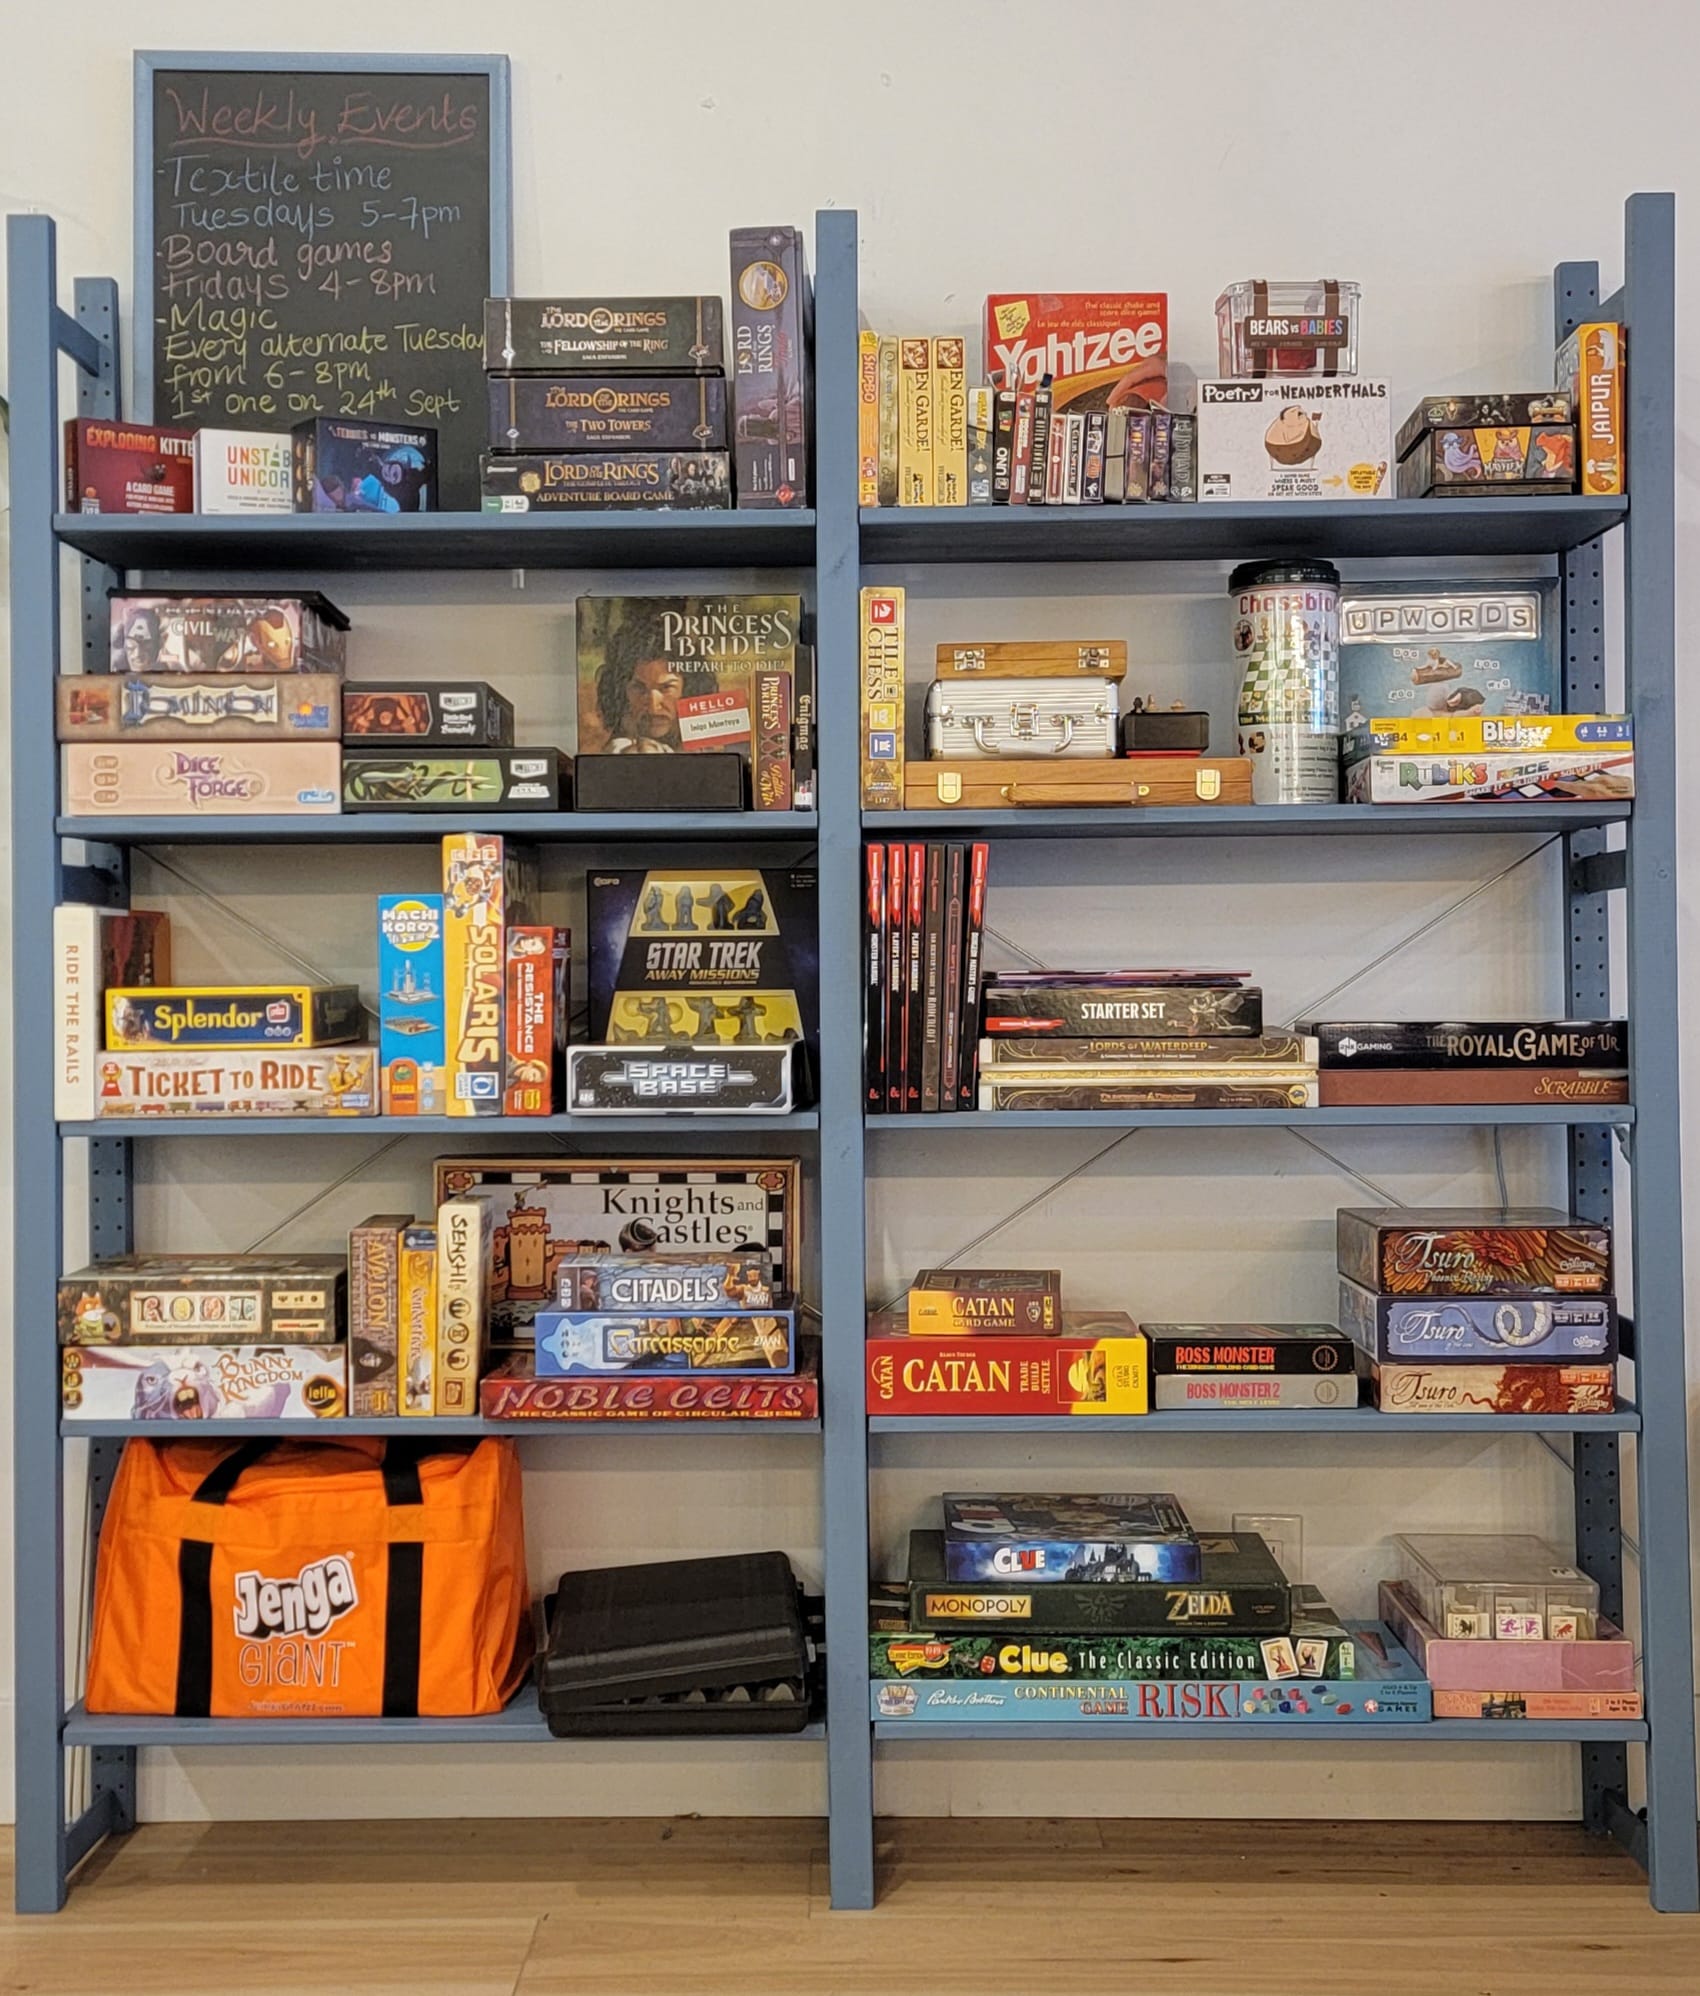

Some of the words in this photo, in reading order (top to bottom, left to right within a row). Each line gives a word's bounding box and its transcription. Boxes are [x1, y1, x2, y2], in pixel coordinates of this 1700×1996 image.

[166, 86, 320, 159] Weekly
[337, 91, 478, 134] Events
[163, 155, 300, 197] Textile
[310, 156, 392, 192] time
[170, 198, 334, 240] Tuesdays
[162, 235, 278, 269] Board
[297, 240, 392, 280] games
[161, 270, 289, 306] Fridays
[170, 299, 278, 339] Magic
[541, 311, 588, 328] LORD
[613, 312, 666, 327] RINGS
[1250, 319, 1289, 336] BEARS
[1301, 319, 1343, 336] BABIES
[163, 331, 248, 371] Every
[261, 326, 389, 357] alternate
[554, 339, 619, 354] FELLOWSHIP
[643, 339, 668, 353] RING
[737, 325, 753, 374] LORD
[757, 324, 773, 373] RINGS
[993, 322, 1162, 391] Yahtzee
[163, 364, 246, 391] from
[916, 371, 929, 391] EN
[951, 371, 963, 390] EN
[170, 388, 213, 420] 1st
[225, 392, 276, 414] one
[287, 394, 324, 412] on
[338, 380, 397, 416] 24th
[404, 388, 461, 417] Sept
[545, 392, 592, 408] LORD
[621, 392, 671, 407] RINGS
[1204, 385, 1261, 402] Poetry
[1281, 383, 1387, 400] NEANDERTHALS
[951, 395, 964, 452] GARDE!
[1591, 373, 1613, 445] JAIPUR
[86, 425, 156, 452] EXPLODING
[581, 420, 606, 431] TWO
[608, 419, 651, 432] TOWERS
[916, 396, 930, 452] GARDE!
[544, 461, 590, 487] LORD
[603, 463, 660, 485] RINGS
[996, 447, 1008, 476] UNO
[126, 481, 131, 491] A
[132, 483, 152, 495] CARD
[153, 485, 175, 497] GAME
[536, 491, 601, 502] ADVENTURE
[604, 491, 641, 502] BOARD
[643, 491, 674, 501] GAME
[704, 605, 740, 614] THE
[1352, 606, 1528, 630] UPWORDS
[170, 619, 214, 638] CIVIL
[660, 610, 792, 651] PRINCESS
[678, 636, 767, 657] BRIDE
[883, 627, 898, 680] TILE
[668, 661, 726, 673] PREPARE
[867, 627, 882, 700] CHESS
[689, 697, 735, 712] HELLO
[763, 676, 781, 731] PRINCESS
[797, 694, 812, 751] Enigmas
[175, 752, 224, 776] DICE
[1399, 759, 1488, 791] Rubik's
[185, 775, 249, 809] FORGE
[382, 909, 439, 921] MACHI
[66, 944, 79, 985] RIDE
[646, 942, 701, 969] STAR
[709, 942, 763, 969] TREK
[645, 969, 686, 981] AWAY
[689, 968, 760, 980] MISSIONS
[456, 925, 499, 1063] SOLARIS
[524, 962, 534, 1054] RESISTANCE
[532, 992, 544, 1025] THE
[66, 992, 80, 1027] THE
[154, 999, 264, 1041] Splendor
[1081, 1002, 1139, 1020] STARTER
[1141, 1002, 1166, 1020] SET
[1090, 1042, 1126, 1052] LORDS
[1141, 1042, 1209, 1052] WATERDEEP
[1356, 1043, 1393, 1051] GAMING
[1426, 1035, 1448, 1047] THE
[1447, 1034, 1514, 1057] ROYAL
[1513, 1028, 1585, 1061] GAME
[1582, 1037, 1596, 1047] OF
[65, 1034, 79, 1085] RAILS
[629, 1063, 727, 1078] SPACE
[127, 1066, 225, 1097] TICKET
[229, 1071, 253, 1090] TO
[260, 1060, 324, 1091] RIDE
[637, 1080, 718, 1096] BASE
[1534, 1076, 1611, 1099] SCRABBLE
[602, 1188, 734, 1224] Knights
[736, 1197, 765, 1212] and
[629, 1217, 750, 1245] Castles
[447, 1214, 468, 1284] SENSHI
[1395, 1231, 1475, 1273] Tsuro
[611, 1278, 720, 1303] CITADELS
[133, 1294, 257, 1322] ROOT
[952, 1296, 1016, 1317] CATAN
[984, 1318, 1016, 1328] GAME
[215, 1352, 294, 1379] BUNNY
[1175, 1346, 1211, 1364] BOSS
[1213, 1346, 1275, 1364] MONSTER
[218, 1370, 303, 1404] KINGDOM
[878, 1355, 894, 1400] CATAN
[902, 1359, 1010, 1393] CATAN
[1020, 1361, 1029, 1393] TRADE
[1031, 1362, 1040, 1391] BUILD
[1042, 1359, 1051, 1394] SETTLE
[1187, 1383, 1216, 1399] BOSS
[1219, 1382, 1271, 1398] MONSTER
[1272, 1382, 1281, 1398] 2
[1391, 1371, 1457, 1405] Tsuro
[491, 1384, 655, 1416] NOBLE
[992, 1547, 1045, 1576] CLUE
[235, 1555, 358, 1640] Jenga
[931, 1599, 1028, 1613] MONOPOLY
[1164, 1591, 1236, 1621] ZELDA
[999, 1645, 1069, 1674] Clue
[1079, 1652, 1107, 1670] The
[1117, 1652, 1180, 1670] Classic
[1190, 1652, 1256, 1670] Edition
[1014, 1686, 1128, 1699] CONTINENTAL
[1136, 1683, 1241, 1720] RISK!
[1080, 1701, 1129, 1714] GAME
